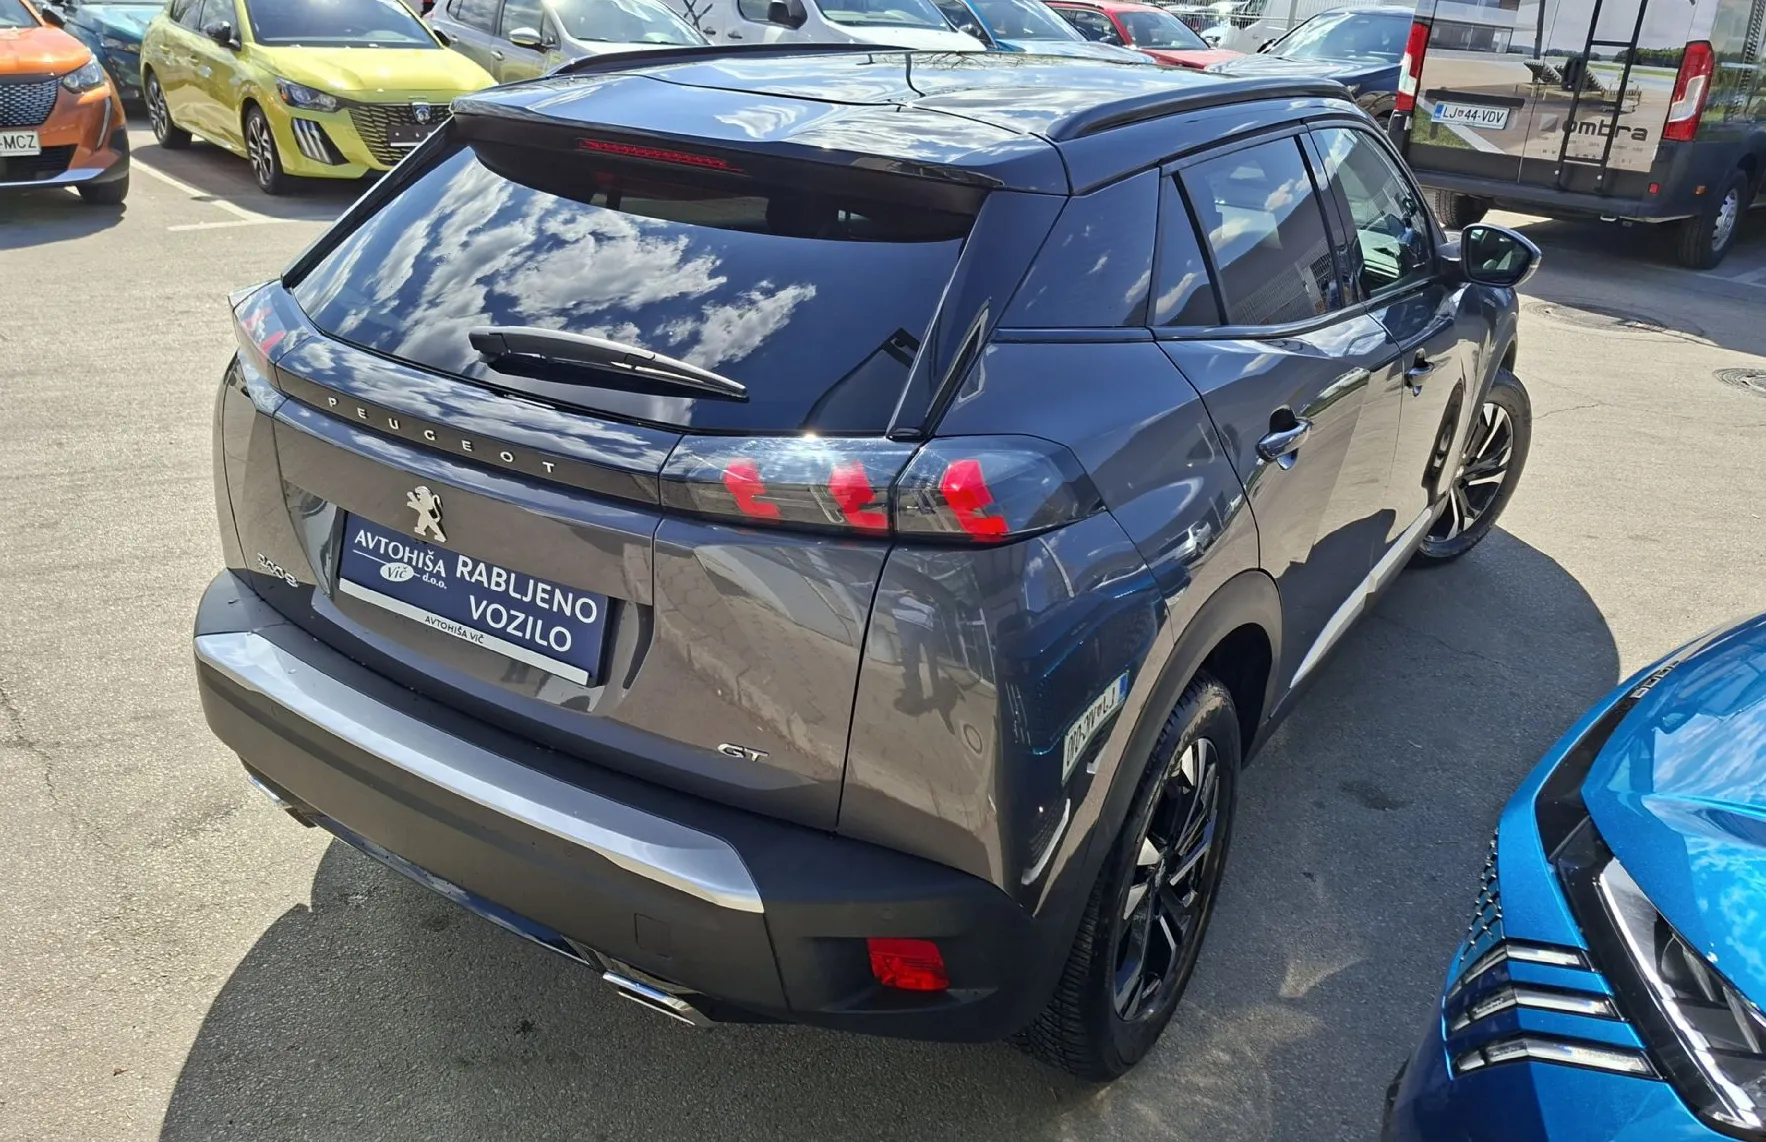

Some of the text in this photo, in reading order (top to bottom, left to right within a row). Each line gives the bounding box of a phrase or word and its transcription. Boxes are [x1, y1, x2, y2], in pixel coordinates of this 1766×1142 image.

[1562, 119, 1649, 141] ombra
[328, 397, 555, 473] PEUGEOT
[354, 529, 446, 578] AVTOHIŠA
[387, 565, 447, 589] Vič d.o.o.
[456, 554, 597, 624] RABLJENO
[425, 615, 468, 639] AVTOHIŠA
[469, 595, 572, 652] VOZILO
[717, 743, 769, 762] GT
